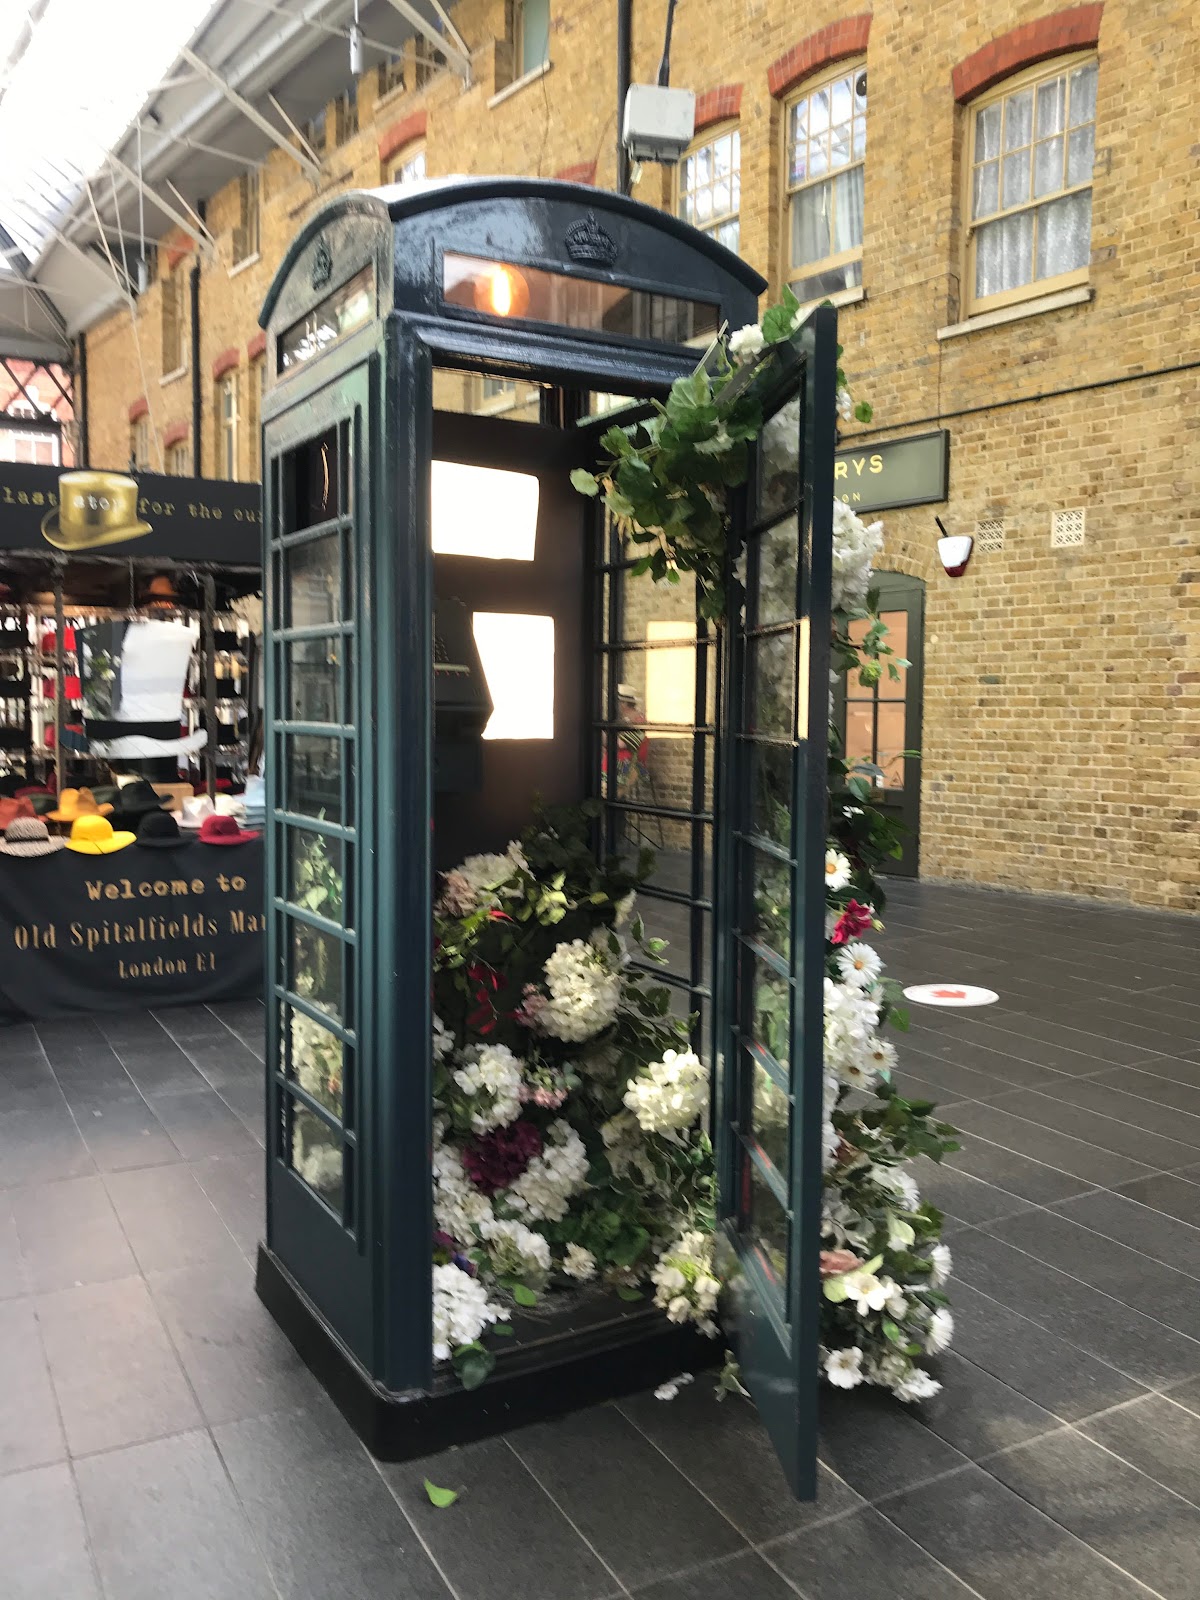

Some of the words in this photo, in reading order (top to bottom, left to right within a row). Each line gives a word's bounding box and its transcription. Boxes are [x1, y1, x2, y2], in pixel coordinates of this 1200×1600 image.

[3, 486, 58, 506] last
[139, 497, 175, 516] for
[188, 502, 223, 520] the
[85, 878, 205, 901] Welcome
[216, 873, 247, 892] to
[14, 923, 57, 950] Old
[70, 913, 219, 952] Spitalfields
[118, 956, 187, 979] London
